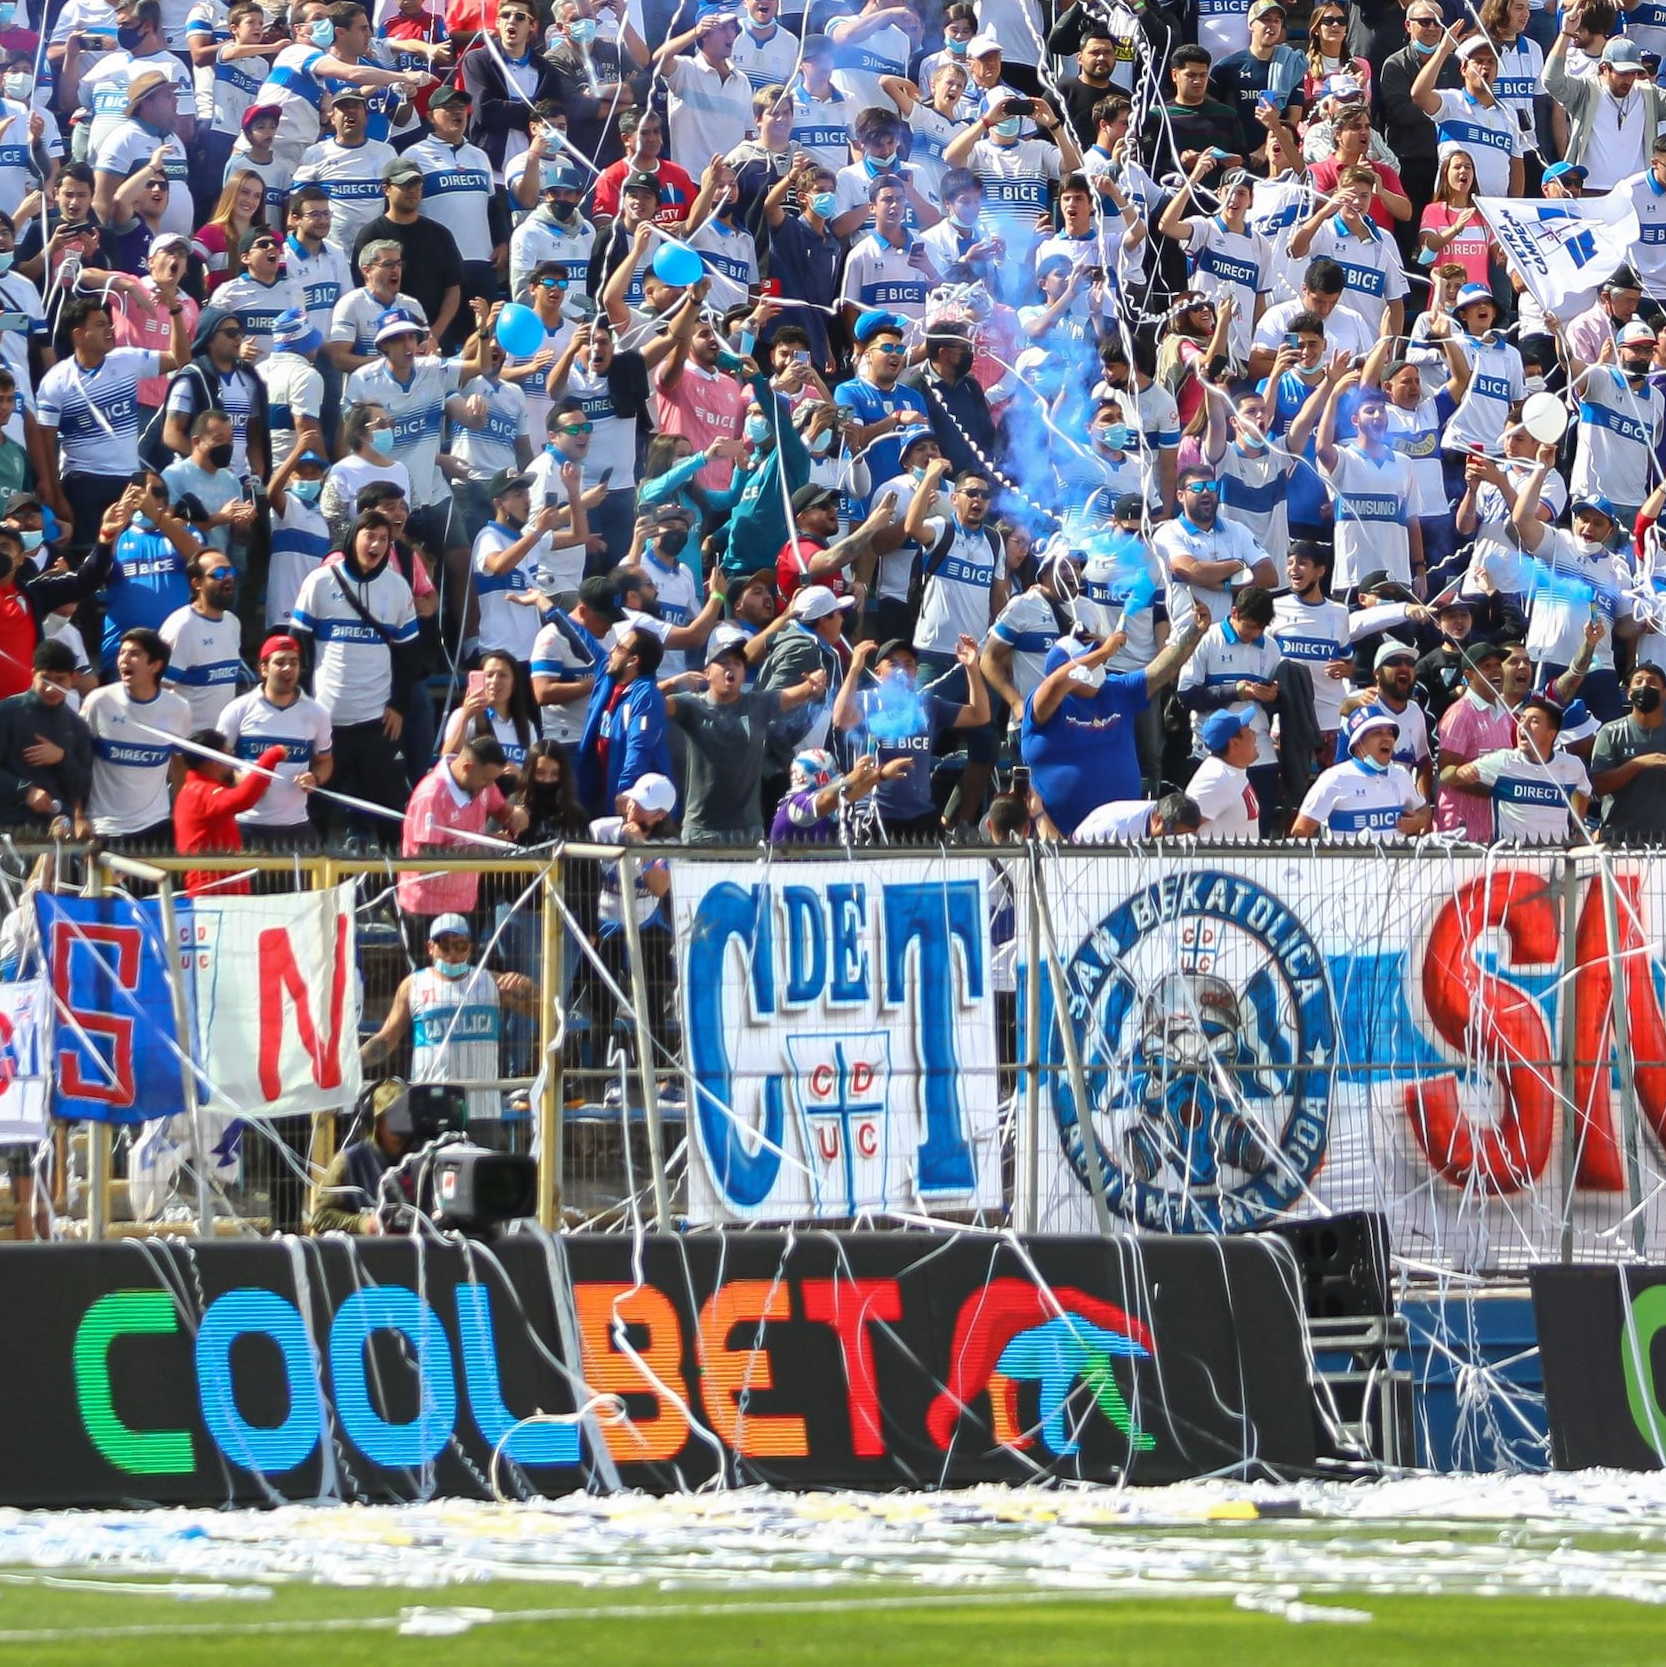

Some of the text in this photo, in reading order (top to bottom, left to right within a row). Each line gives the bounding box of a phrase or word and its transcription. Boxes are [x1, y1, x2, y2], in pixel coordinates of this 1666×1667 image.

[1214, 0, 1248, 12] BICE
[1504, 81, 1534, 94] BICE
[814, 131, 846, 144] BICE
[1482, 132, 1511, 148] BICE
[439, 174, 488, 188] DIRECTV
[1003, 185, 1038, 201] BICE
[1498, 224, 1533, 268] TETRA
[1347, 269, 1379, 289] BICE
[889, 287, 918, 300] BICE
[247, 318, 274, 328] DIRE
[1479, 377, 1508, 395] BICE
[100, 400, 130, 421] ICE
[393, 418, 426, 436] BICE
[490, 420, 518, 436] BICE
[707, 412, 736, 428] BICE
[1340, 498, 1396, 516] SAMSUNG
[961, 567, 992, 582] BICE
[331, 626, 376, 640] DIRECT
[1281, 640, 1334, 658] DIRECTV
[896, 738, 929, 750] BICE
[109, 745, 166, 764] DIRECTV
[1130, 876, 1326, 1001] BEKATOLICA
[52, 922, 142, 1107] S
[258, 913, 348, 1102] N
[72, 1276, 902, 1476] COOLBET
